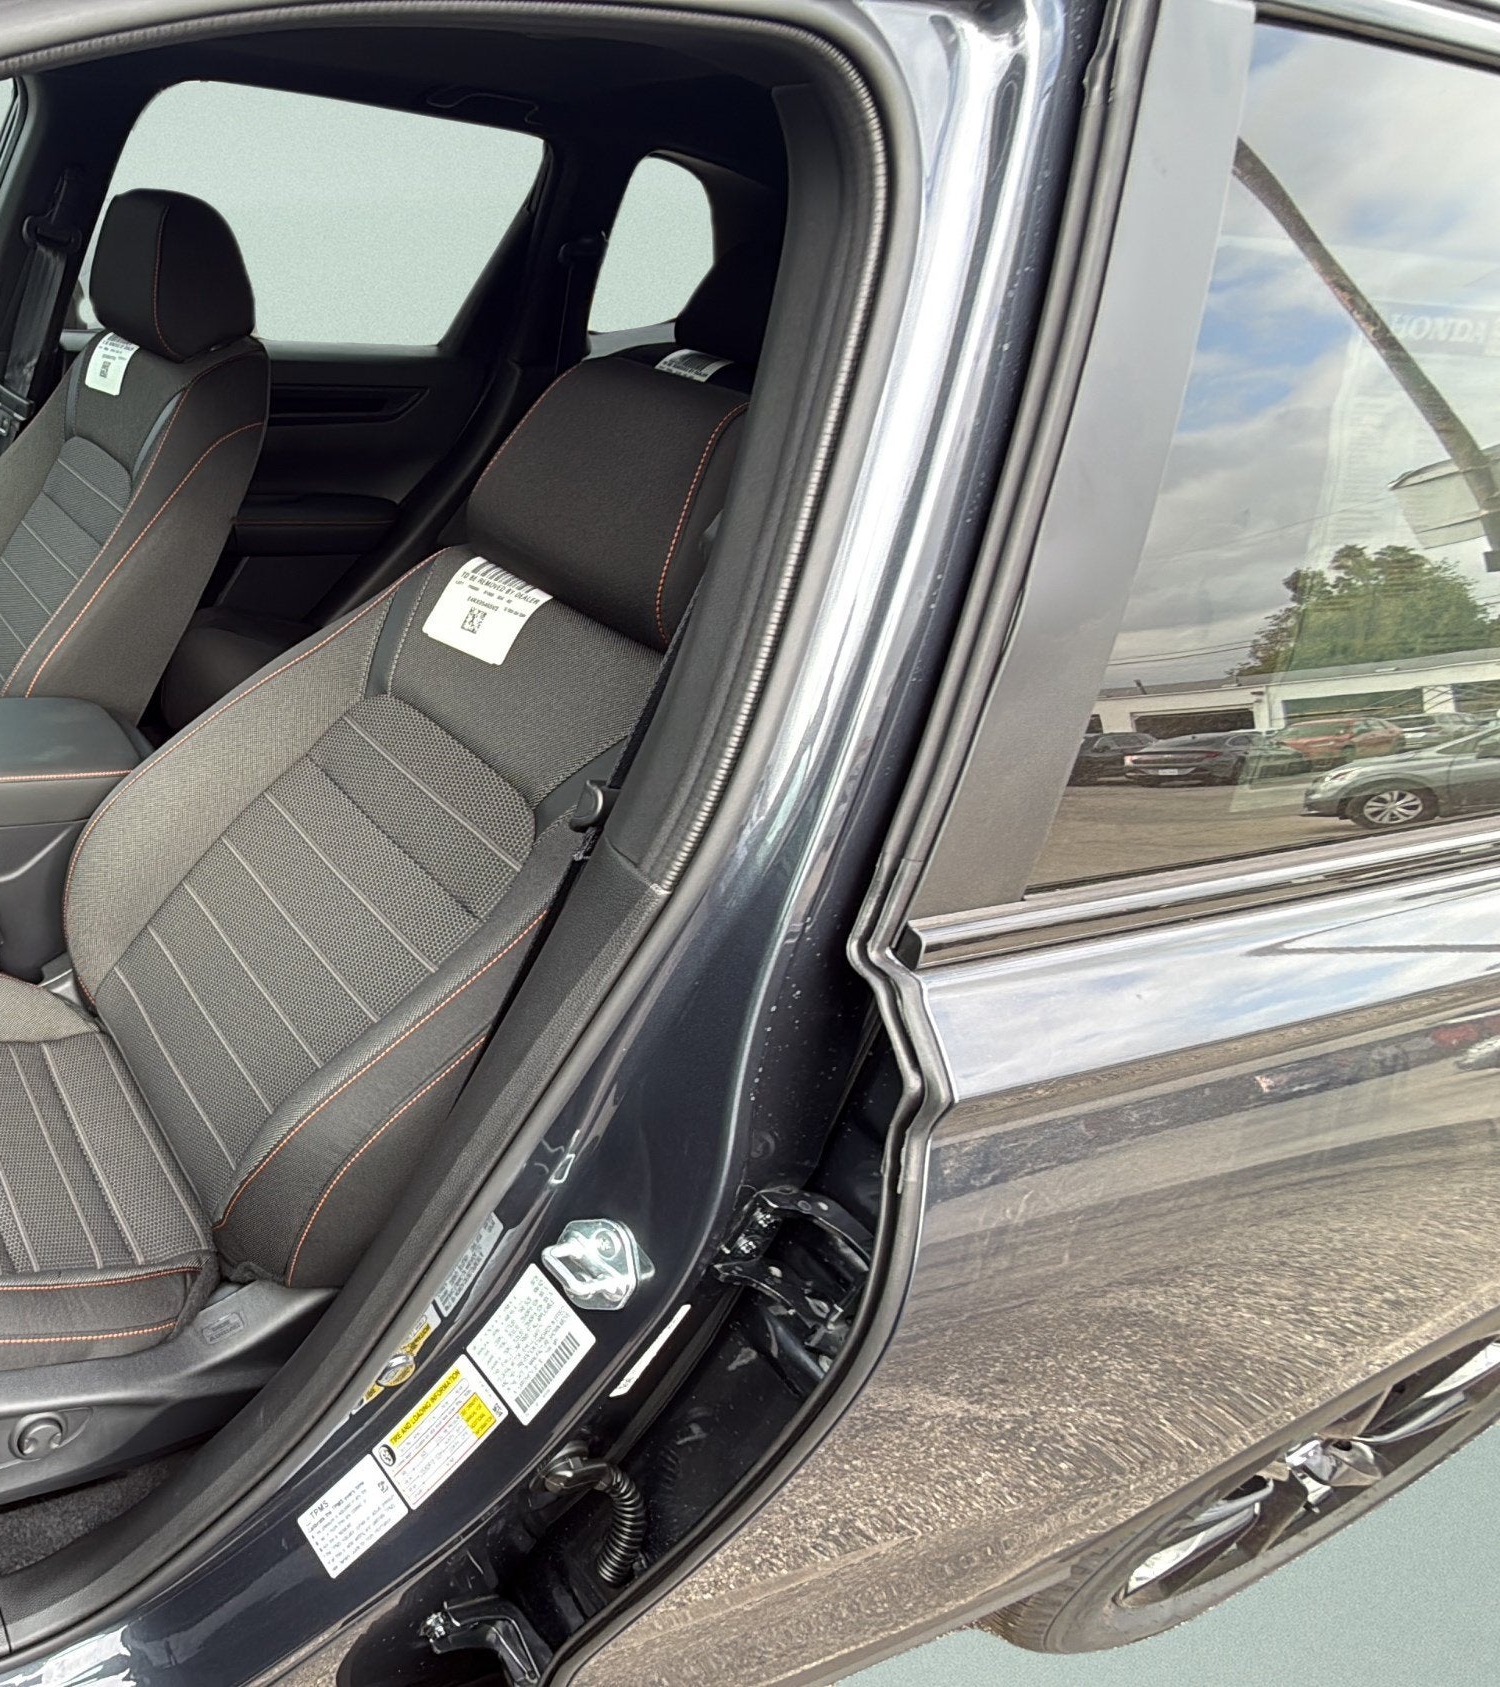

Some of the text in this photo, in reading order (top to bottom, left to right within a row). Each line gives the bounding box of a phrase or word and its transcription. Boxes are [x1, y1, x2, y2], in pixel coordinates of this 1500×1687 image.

[477, 578, 505, 592] REMOVED
[515, 592, 540, 605] DEALER
[390, 1369, 460, 1445] TIRE AND LOADING INFORMATION
[310, 1500, 329, 1519] TPMS
